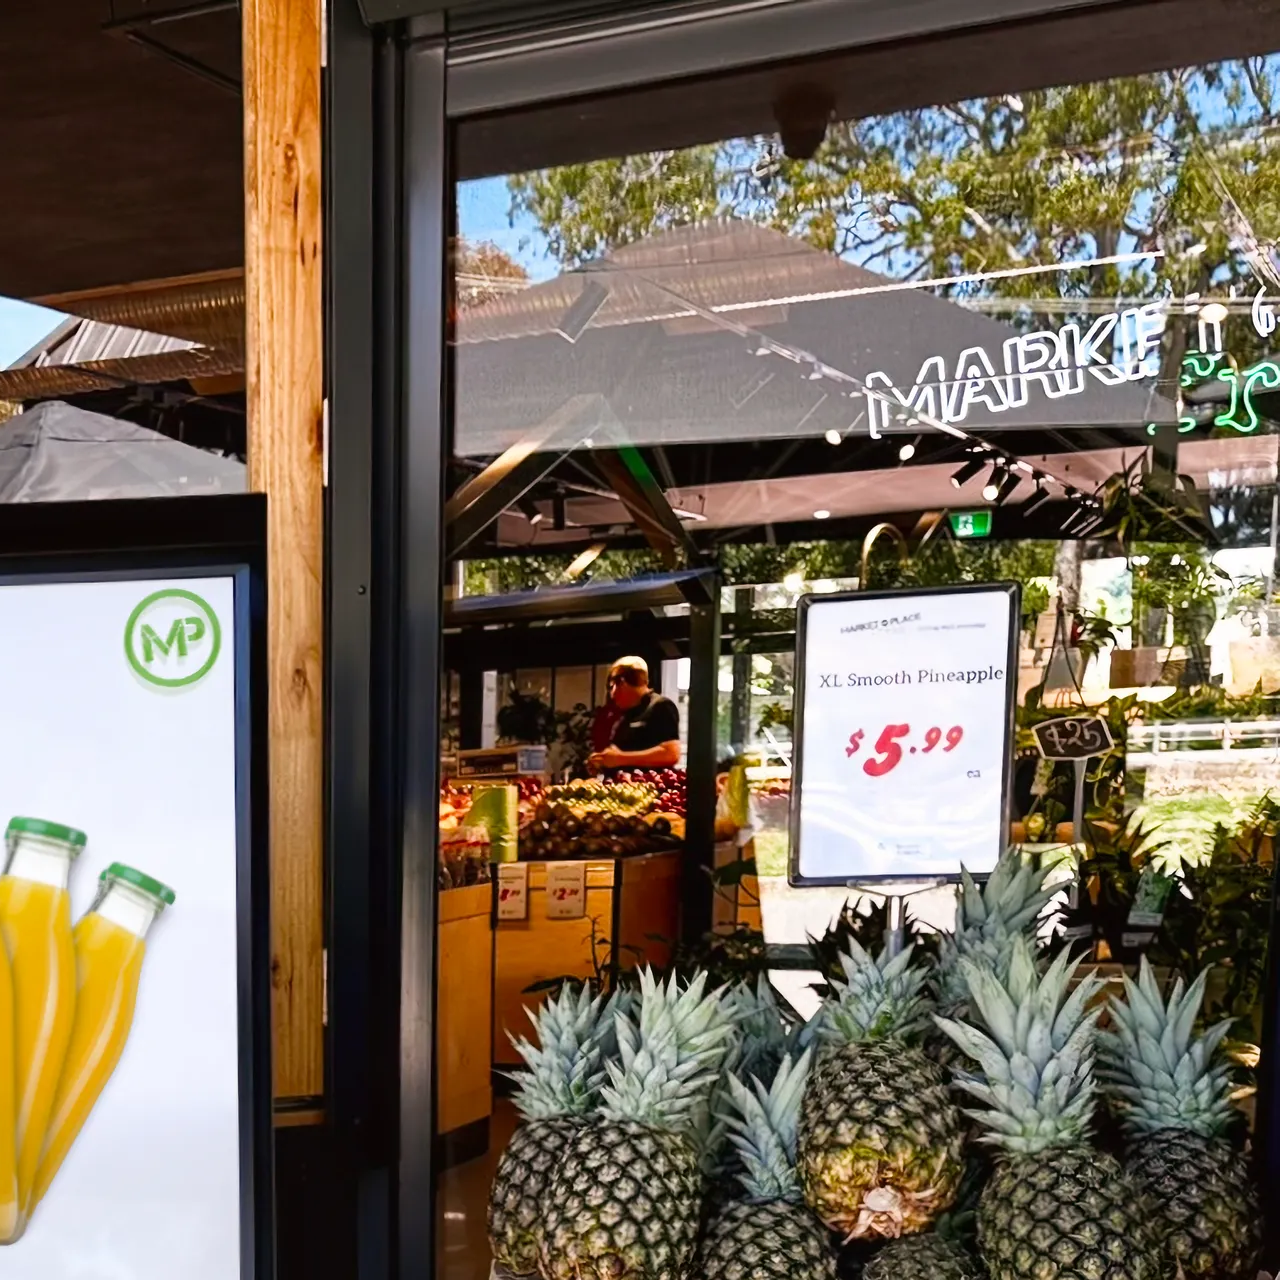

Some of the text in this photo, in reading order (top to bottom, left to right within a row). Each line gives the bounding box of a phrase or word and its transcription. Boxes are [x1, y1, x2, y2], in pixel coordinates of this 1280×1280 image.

[889, 612, 922, 625] PLACE
[140, 616, 206, 664] MP
[819, 665, 1004, 688] XL Smooth Pineapple
